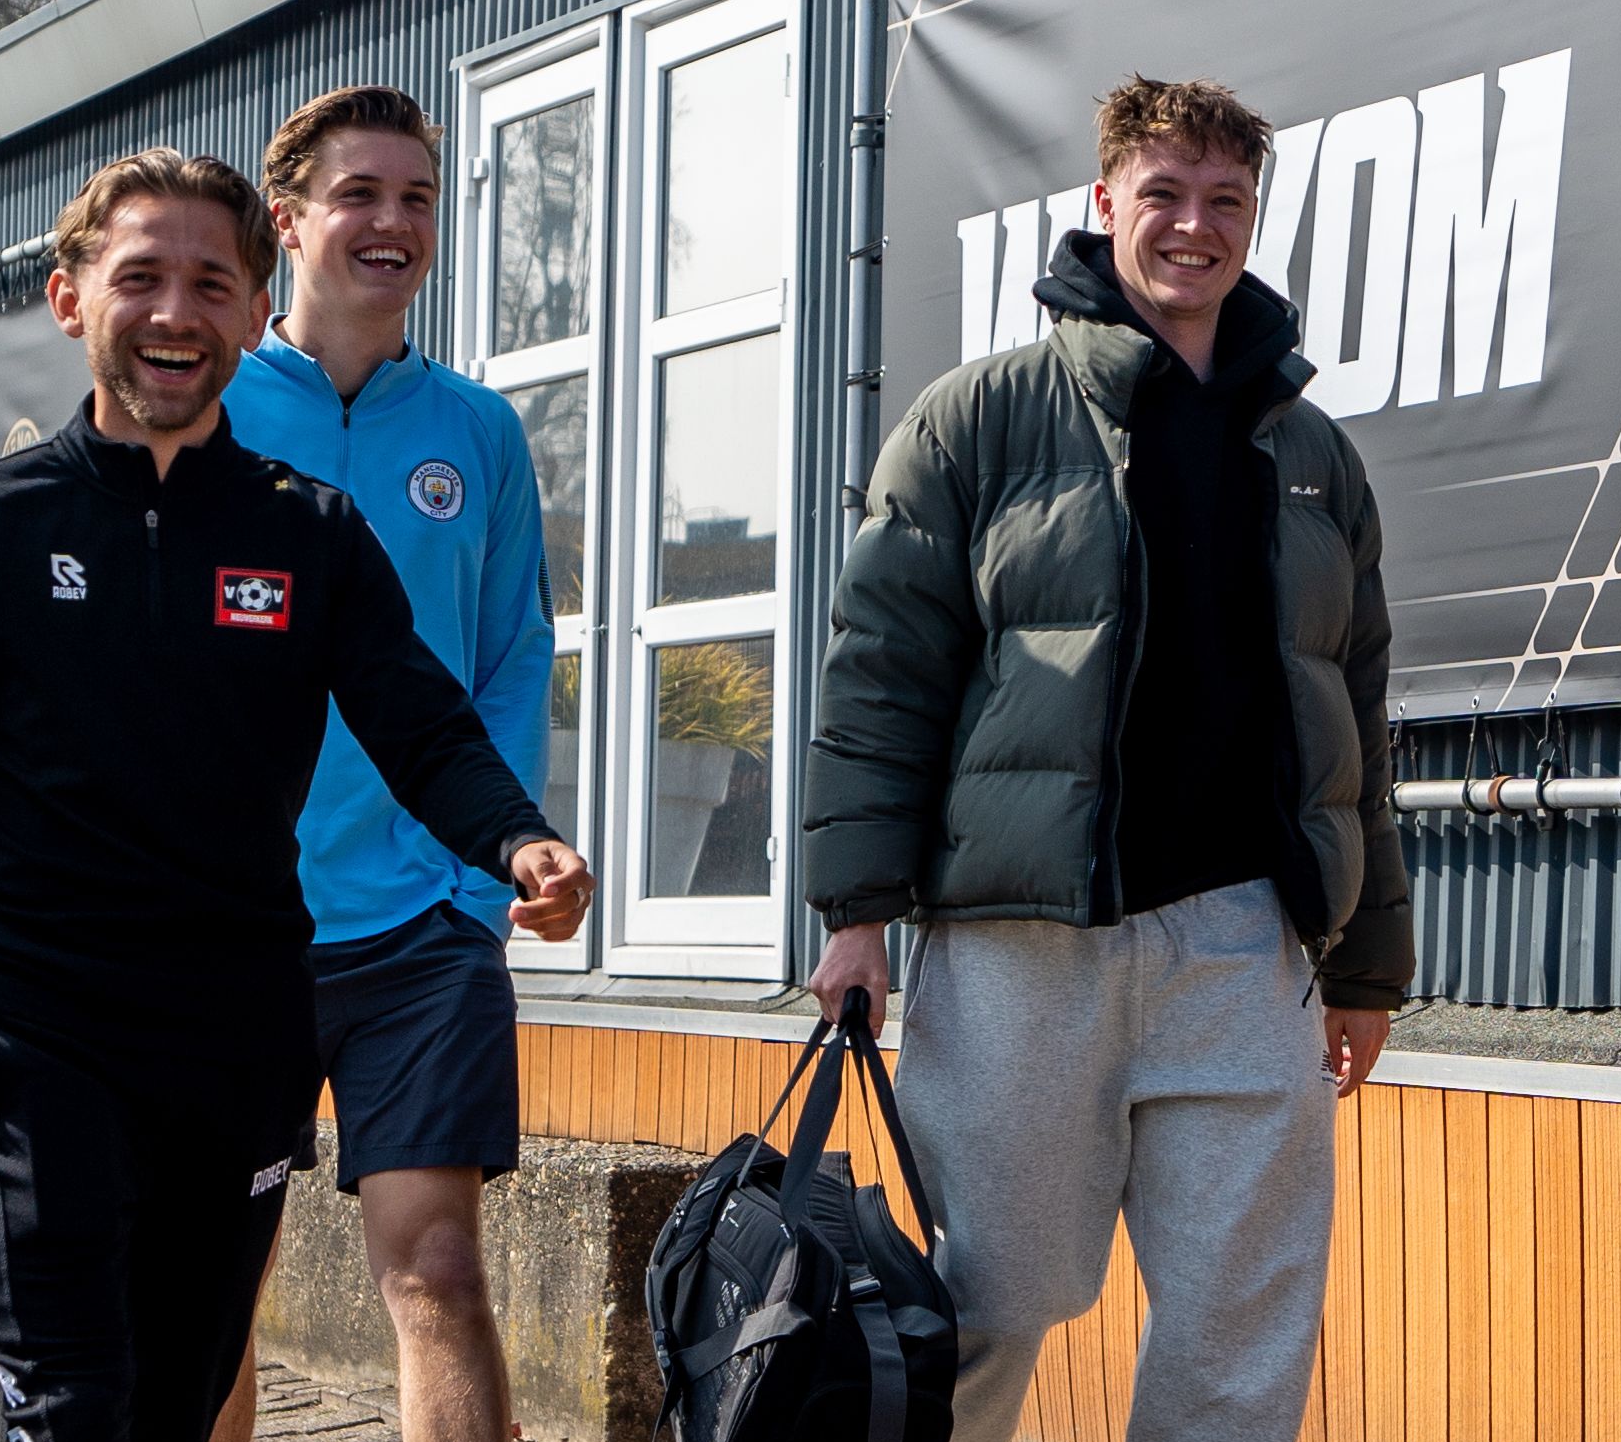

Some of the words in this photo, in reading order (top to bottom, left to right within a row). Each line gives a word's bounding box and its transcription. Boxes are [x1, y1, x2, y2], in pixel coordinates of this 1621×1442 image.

[413, 464, 460, 488] MANCHESTER
[429, 509, 448, 518] CITY
[52, 585, 87, 600] ROBEY
[223, 585, 236, 600] V
[272, 589, 285, 604] V
[250, 1155, 292, 1197] ROBEY
